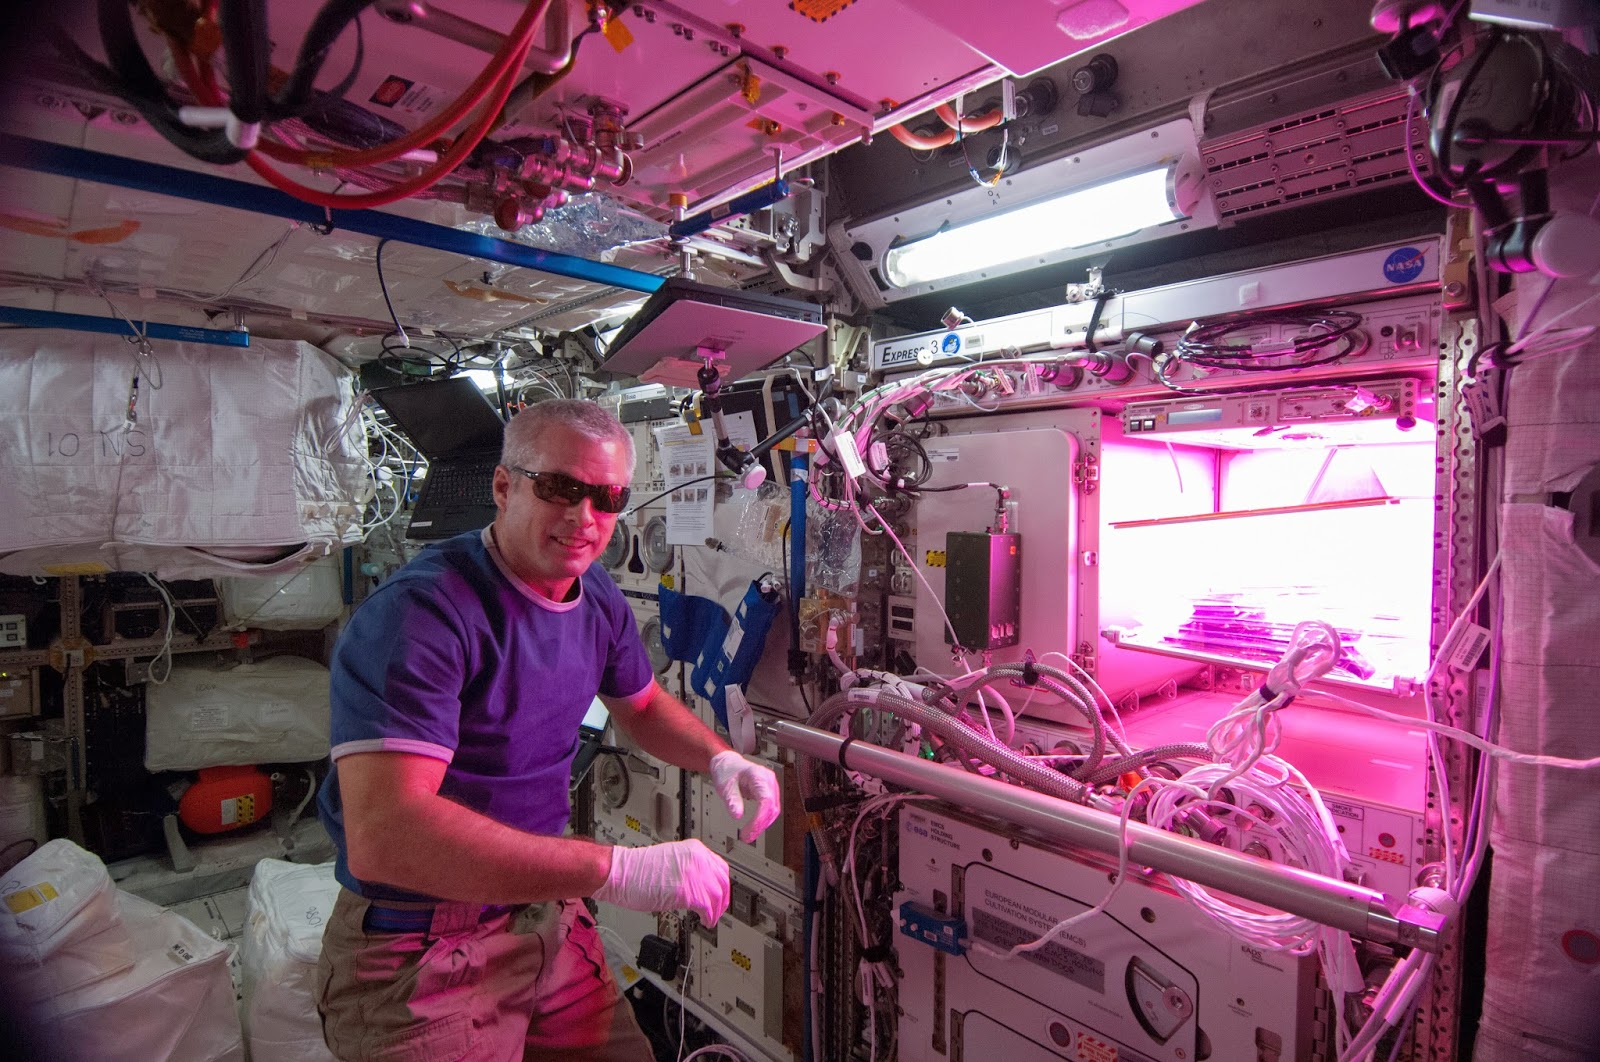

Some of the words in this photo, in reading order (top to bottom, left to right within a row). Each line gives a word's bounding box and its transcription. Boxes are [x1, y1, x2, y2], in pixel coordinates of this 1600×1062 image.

[1386, 259, 1422, 272] NASA
[930, 340, 939, 355] 3
[931, 828, 953, 840] HOLDING
[931, 835, 960, 850] STRUCTURE
[985, 889, 1022, 910] EUROPEAN
[1023, 905, 1058, 925] MODULAR
[985, 898, 1028, 922] CULTIVATION
[1028, 916, 1055, 933] SYSTE
[1059, 930, 1087, 949] (EMCS)
